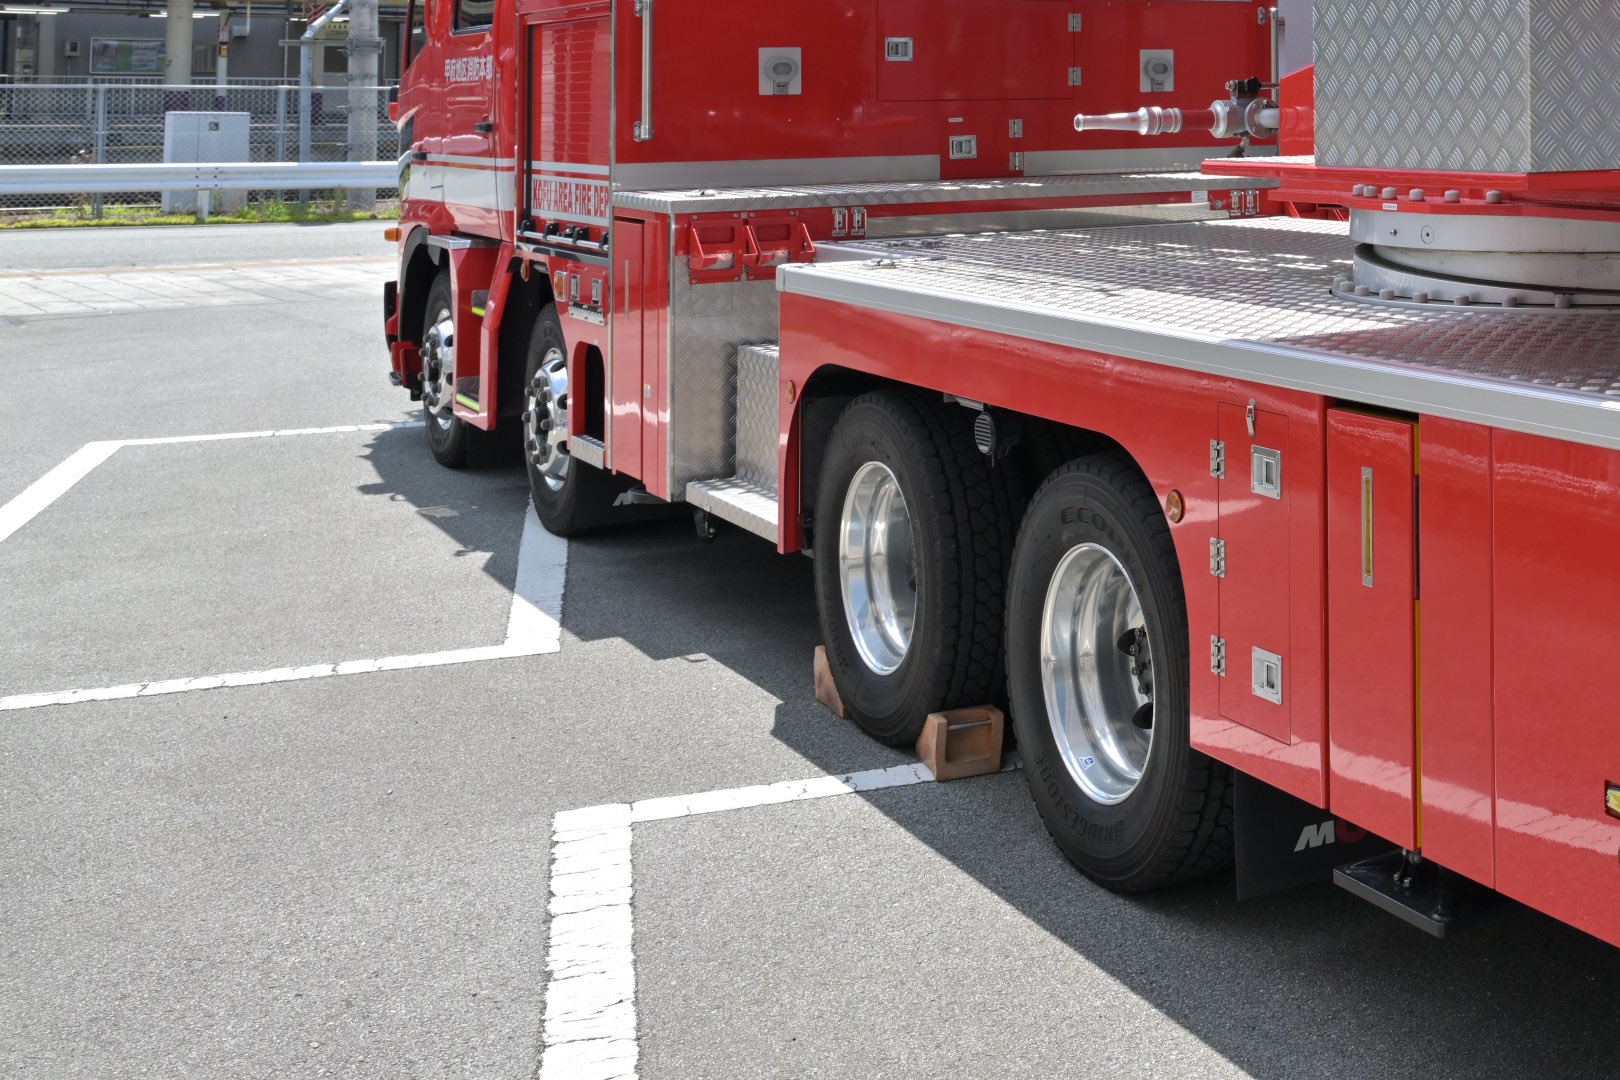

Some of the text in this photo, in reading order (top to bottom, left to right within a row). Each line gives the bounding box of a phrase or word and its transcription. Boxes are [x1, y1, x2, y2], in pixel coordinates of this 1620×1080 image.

[445, 55, 493, 84] 甲府地区消防本部
[533, 179, 551, 211] KOFU
[554, 181, 572, 214] AREA
[575, 183, 592, 216] FIRE
